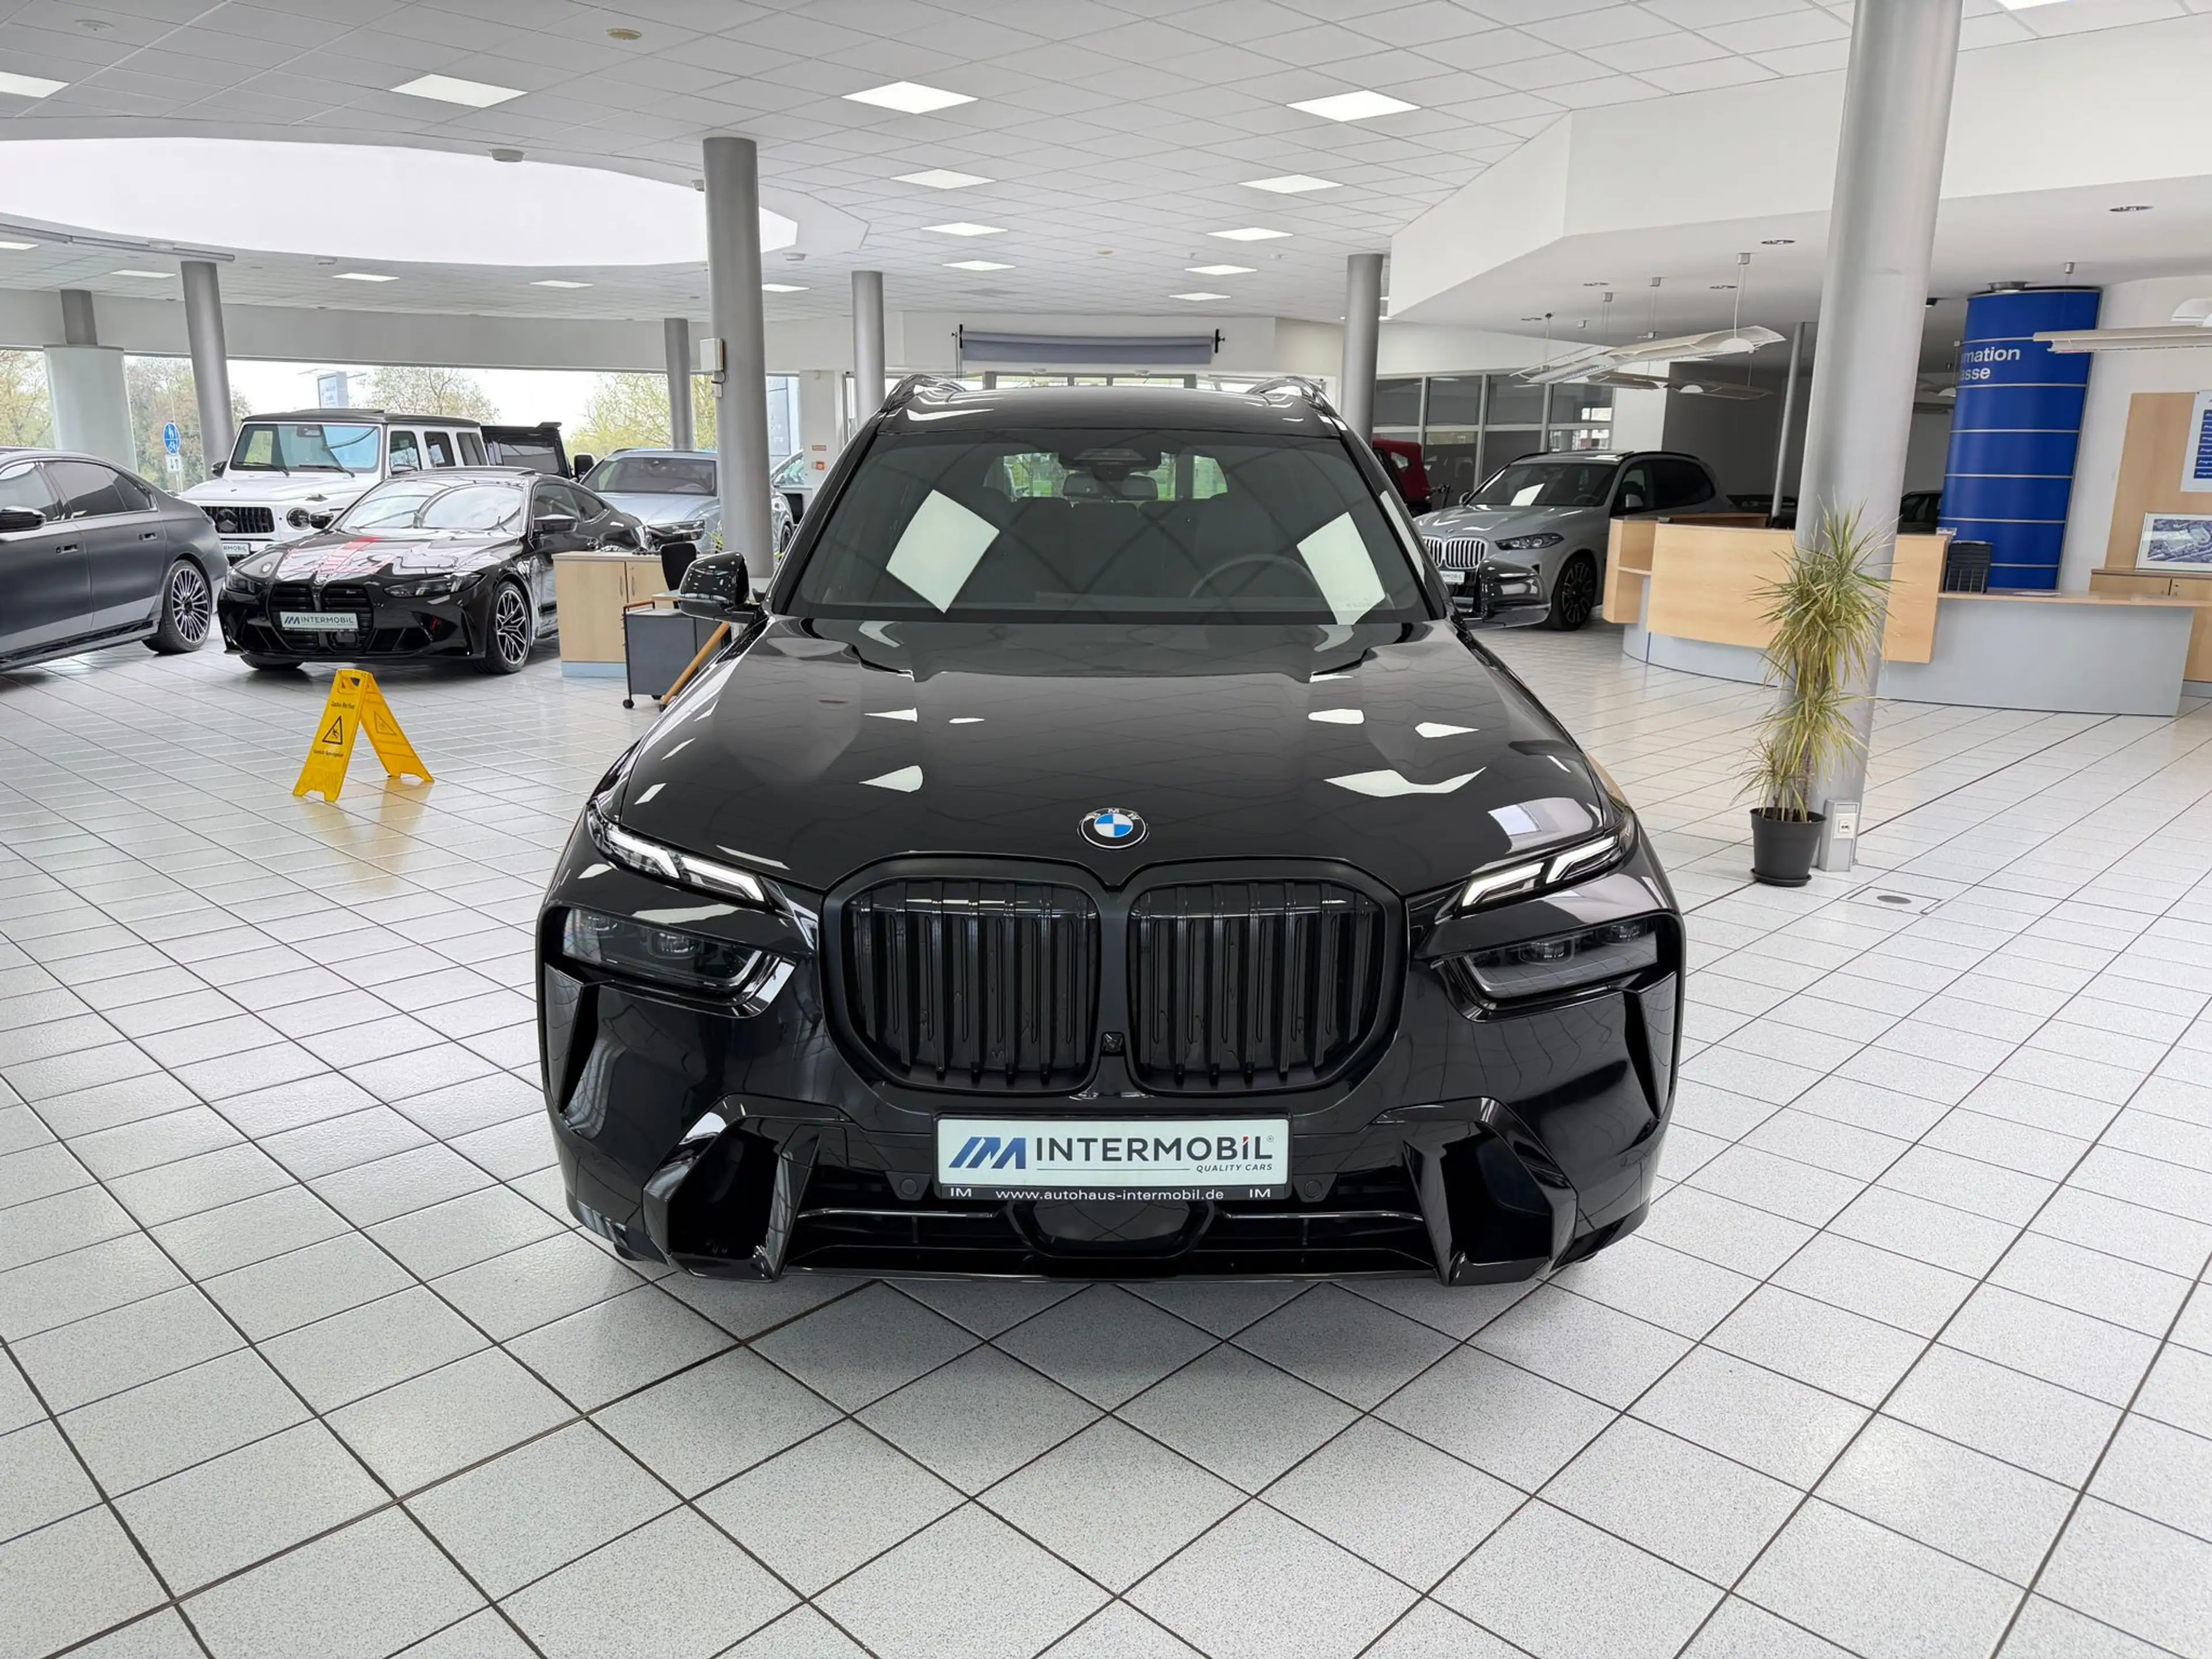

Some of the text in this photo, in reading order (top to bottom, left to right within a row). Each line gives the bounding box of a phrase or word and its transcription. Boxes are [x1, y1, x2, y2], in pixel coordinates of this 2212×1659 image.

[1037, 1136, 1272, 1161] INTERMOBIL
[1196, 1164, 1241, 1173] QUALITY
[950, 1188, 1271, 1200] IM www.autohaus-intermobil.de IM
